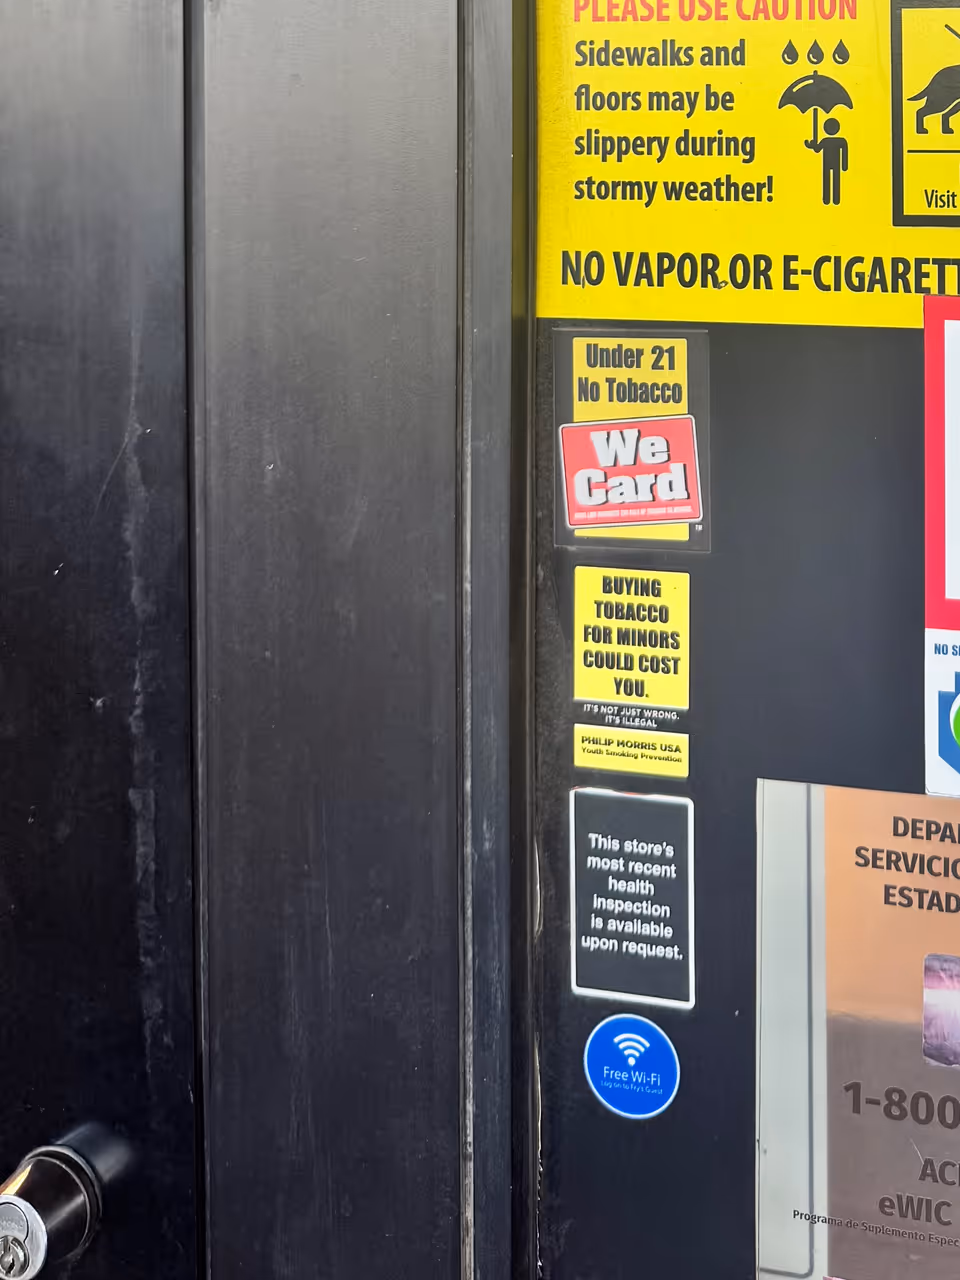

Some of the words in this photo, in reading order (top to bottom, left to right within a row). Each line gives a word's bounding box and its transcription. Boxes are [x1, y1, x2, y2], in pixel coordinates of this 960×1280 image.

[575, 39, 694, 66] Sidewalks
[700, 39, 745, 66] and
[574, 84, 641, 111] floors
[649, 91, 699, 118] may
[706, 84, 734, 111] be
[575, 129, 670, 163] slippery
[676, 129, 755, 163] during
[574, 176, 658, 208] stormy
[663, 175, 773, 202] weather!
[924, 190, 957, 208] Visit
[562, 250, 605, 287] NO
[612, 251, 721, 288] VAPOR
[729, 253, 773, 290] OR
[587, 344, 644, 368] Under
[651, 345, 675, 370] 21
[578, 377, 600, 402] No
[606, 377, 682, 403] Tobacco
[590, 428, 670, 468] We
[574, 463, 689, 507] Card
[603, 576, 661, 597] BUYING
[594, 600, 669, 623] TOBACCO
[584, 625, 612, 644] FOR
[617, 628, 680, 649] MINORS
[935, 644, 948, 655] NO
[584, 650, 634, 671] COULD
[639, 655, 680, 674] COST
[614, 677, 648, 697] YOU.
[588, 833, 619, 851] This
[624, 839, 674, 857] store's
[587, 856, 624, 871] most
[629, 861, 676, 878] recent
[609, 876, 654, 895] health
[594, 895, 670, 917] inspection
[591, 914, 603, 929] is
[607, 919, 673, 938] available
[582, 936, 618, 951] upon
[623, 941, 682, 960] request.
[604, 1065, 629, 1081] Free
[631, 1070, 661, 1086] Wi-Fi
